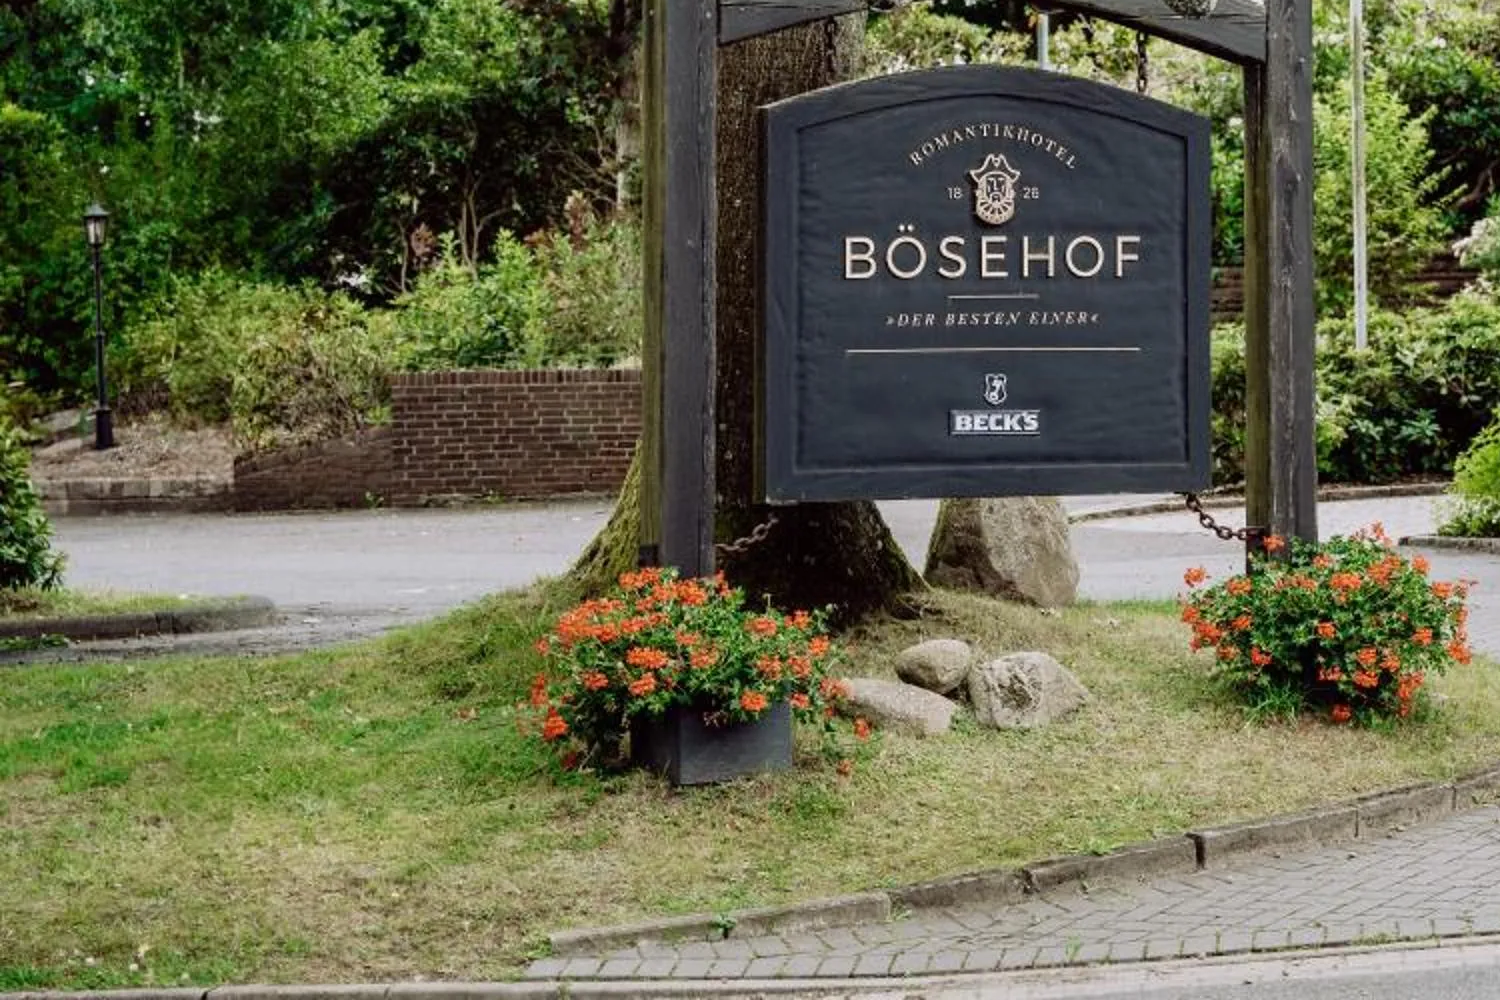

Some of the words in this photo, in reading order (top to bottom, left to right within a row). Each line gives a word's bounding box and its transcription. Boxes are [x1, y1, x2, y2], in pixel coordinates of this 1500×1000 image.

[909, 124, 1077, 169] ROMANTIKHOTEL
[947, 187, 963, 199] 18
[844, 224, 1141, 280] BÖSEHOF
[944, 311, 1021, 327] BESTEN
[954, 412, 1039, 432] BECK'S
